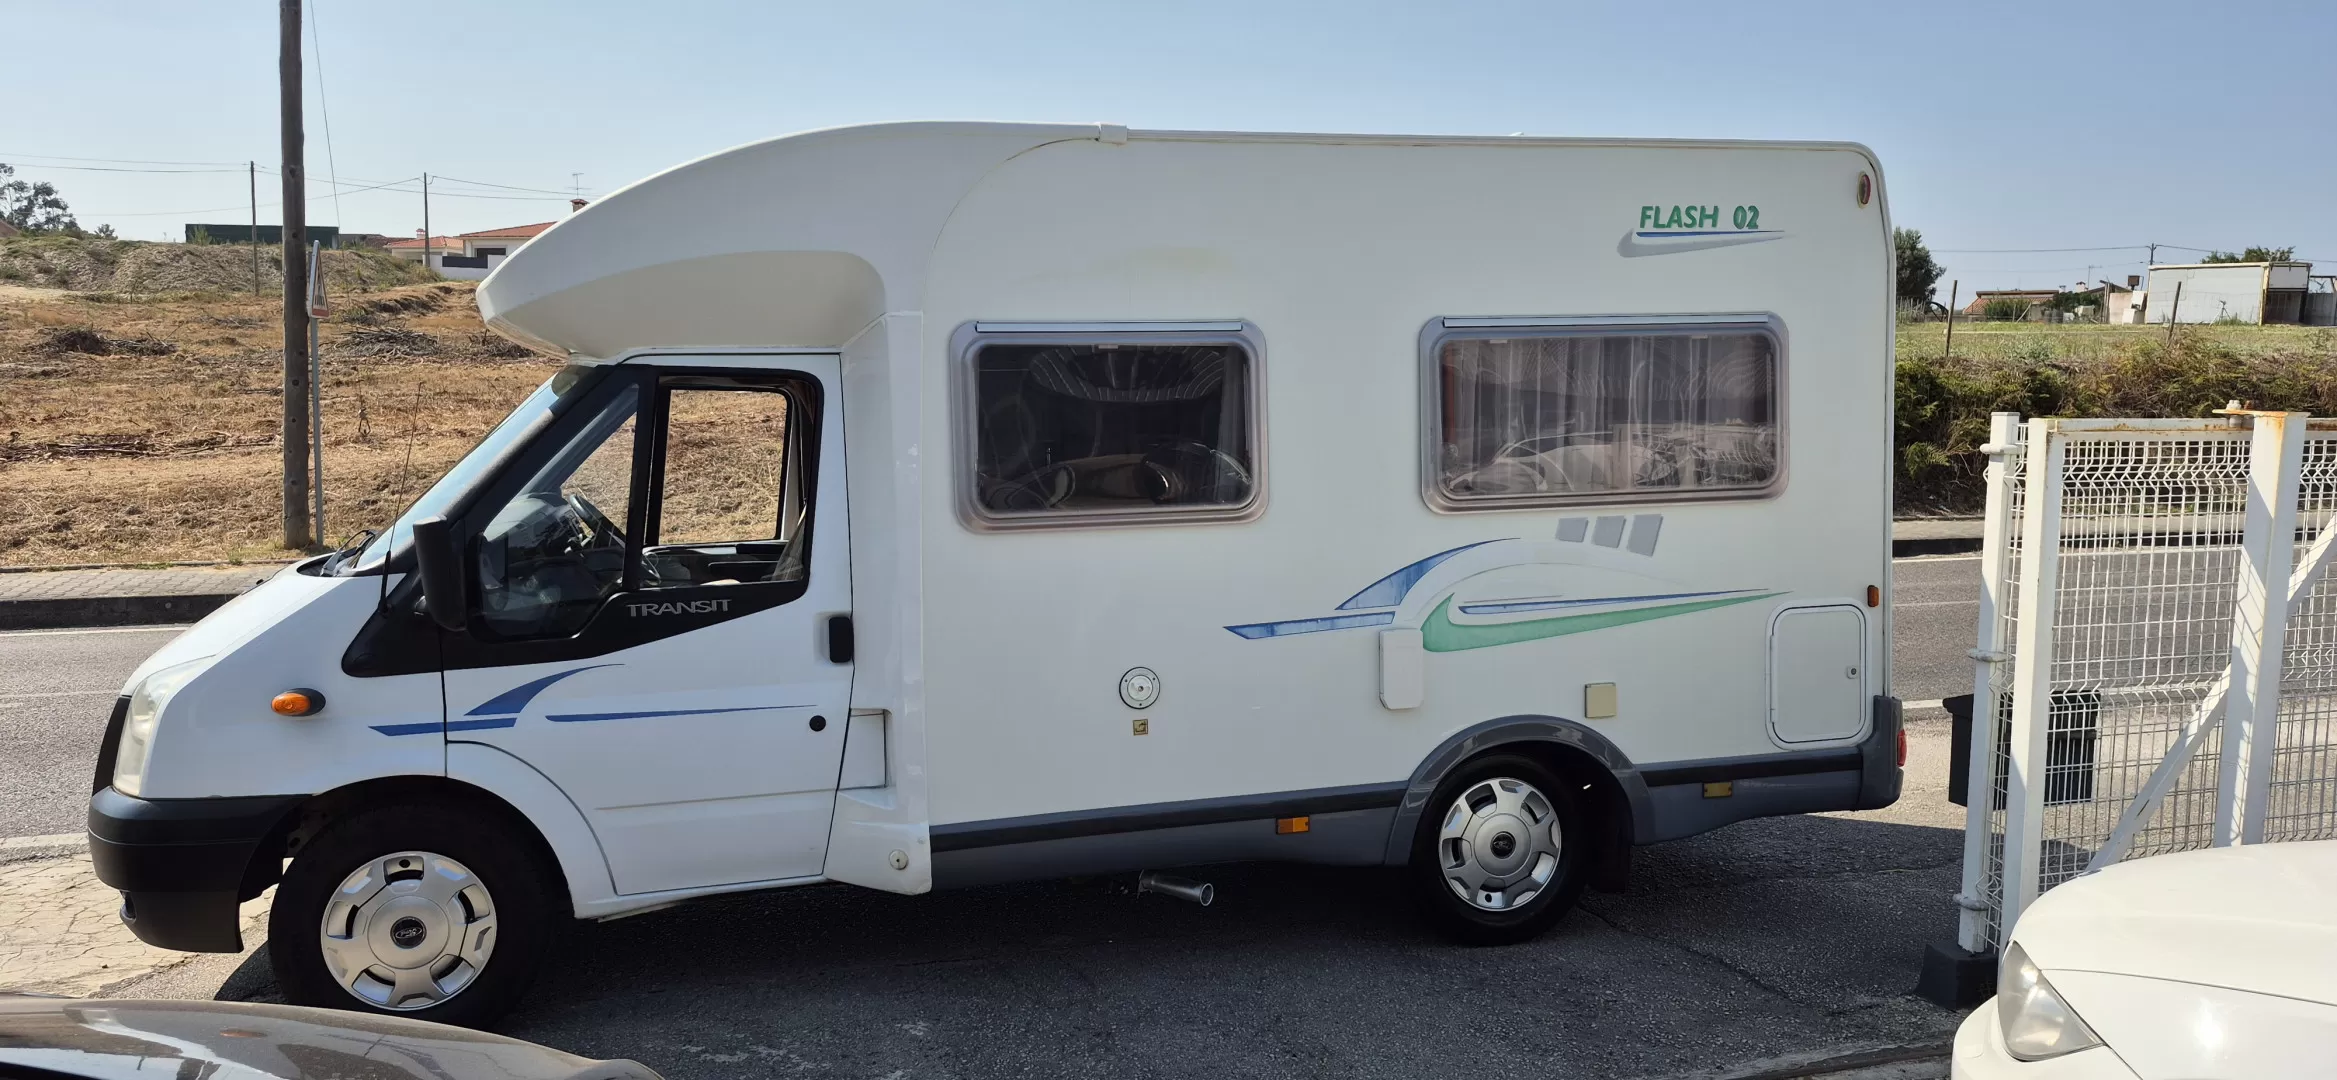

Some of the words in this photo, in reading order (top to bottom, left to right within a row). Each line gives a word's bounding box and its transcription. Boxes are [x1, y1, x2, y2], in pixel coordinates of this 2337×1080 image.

[1639, 205, 1719, 229] FLASH
[1733, 205, 1760, 230] 02
[626, 599, 732, 617] TRANSIT
